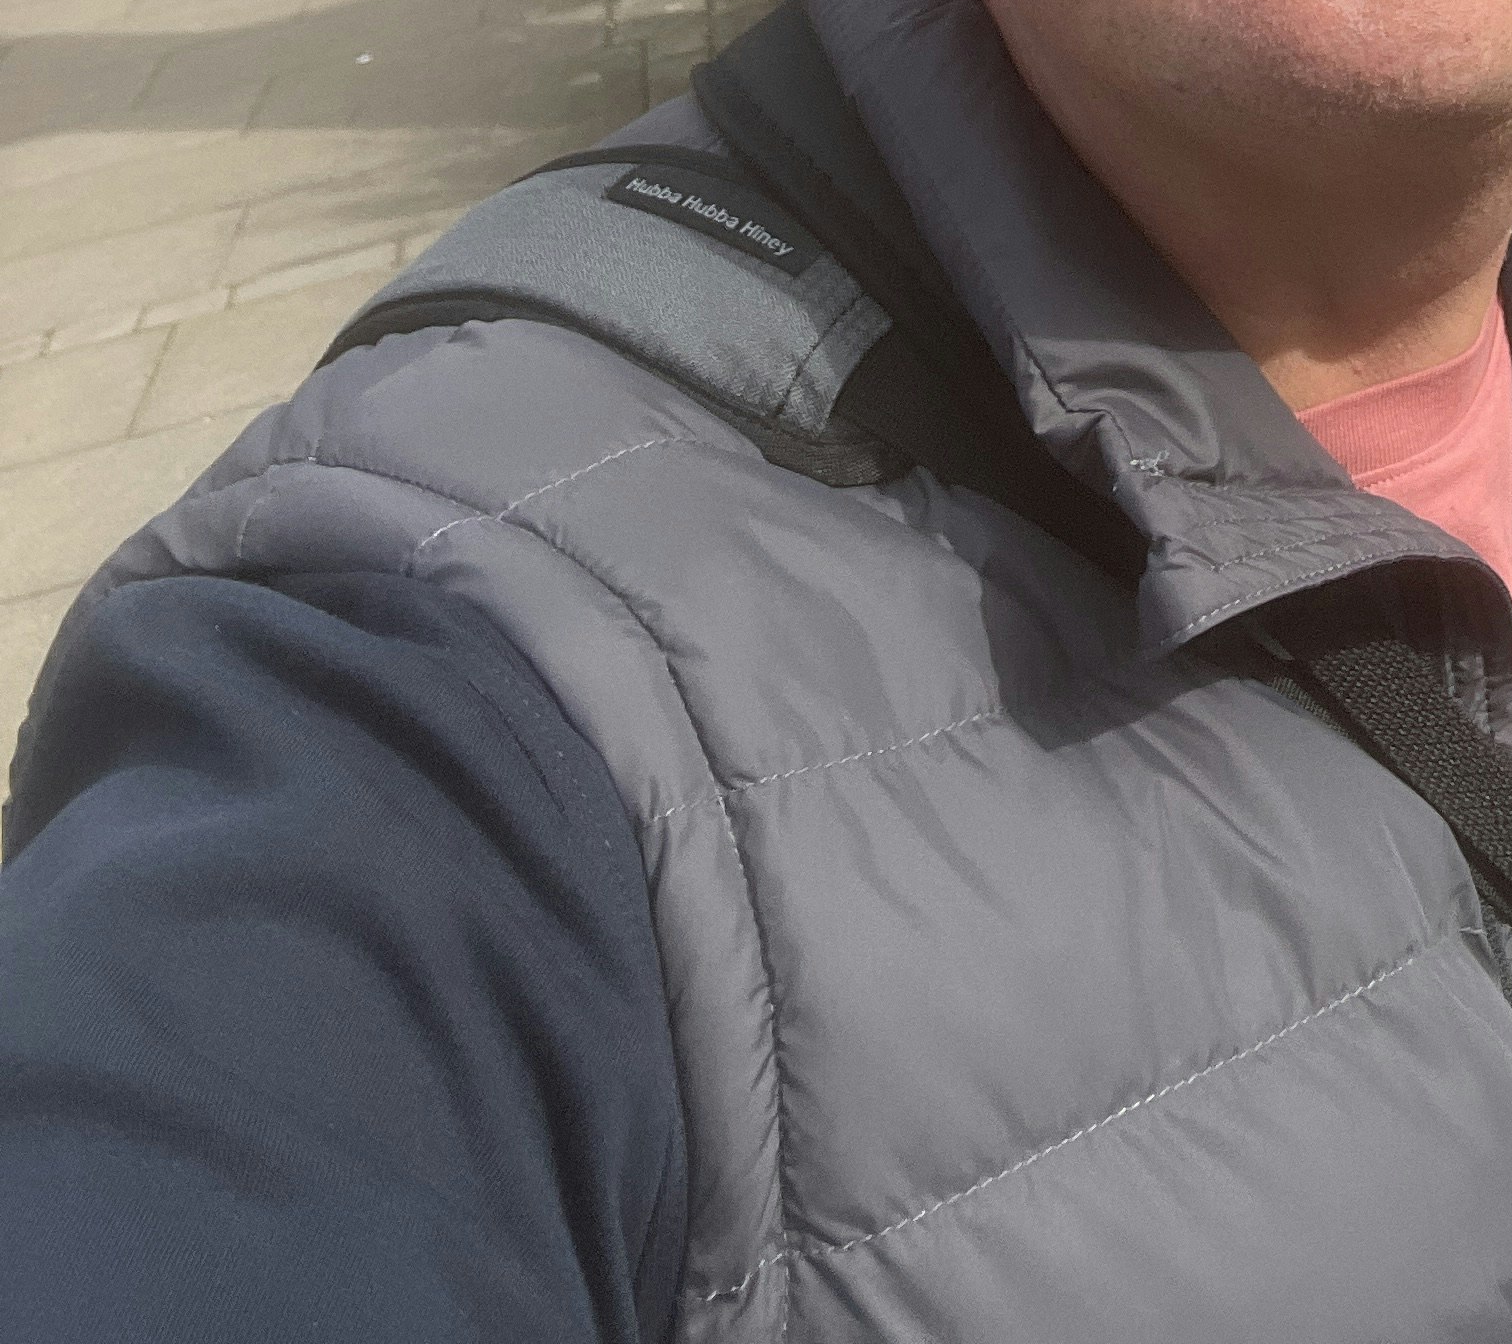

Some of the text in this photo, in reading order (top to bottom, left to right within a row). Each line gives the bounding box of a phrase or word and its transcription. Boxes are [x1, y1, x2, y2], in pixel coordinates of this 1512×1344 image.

[625, 177, 794, 256] Hubba Hubba Hiney
